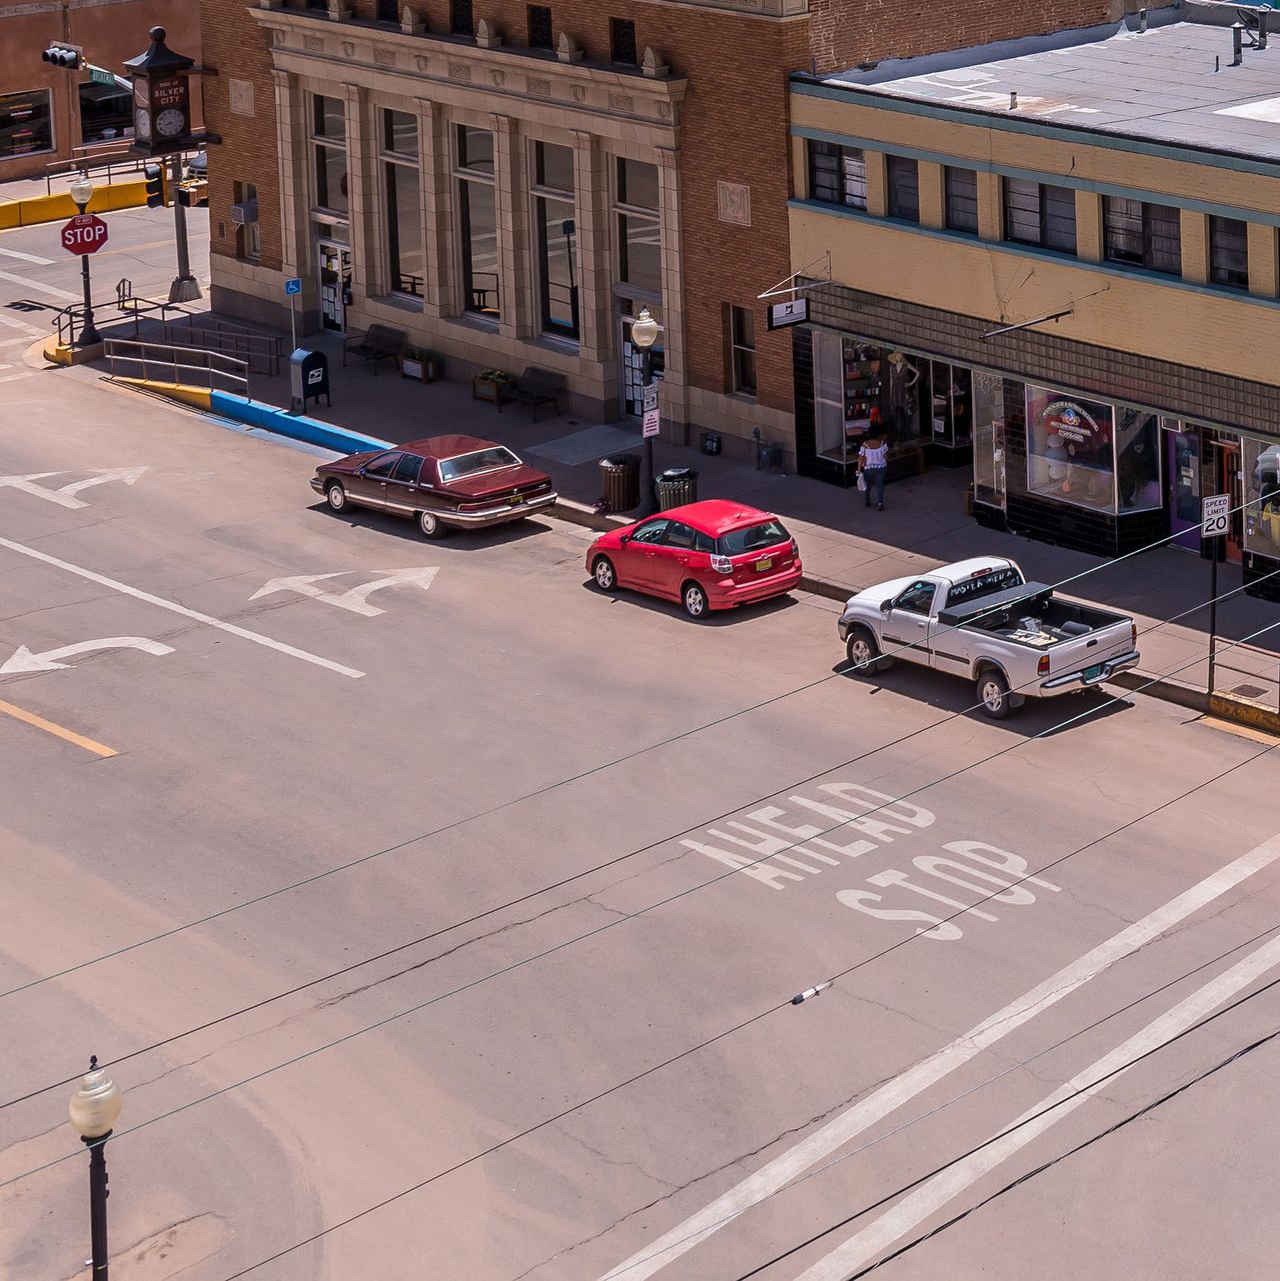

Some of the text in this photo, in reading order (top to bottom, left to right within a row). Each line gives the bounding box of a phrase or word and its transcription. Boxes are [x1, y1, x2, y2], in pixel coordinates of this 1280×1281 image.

[154, 87, 185, 97] SILVER
[161, 96, 180, 105] CITY
[65, 226, 105, 245] STOP
[1205, 499, 1228, 509] SPEED
[1207, 508, 1225, 516] LIMIT
[1205, 515, 1227, 533] 20
[678, 781, 937, 891] AHEAD
[835, 839, 1063, 942] STOP
